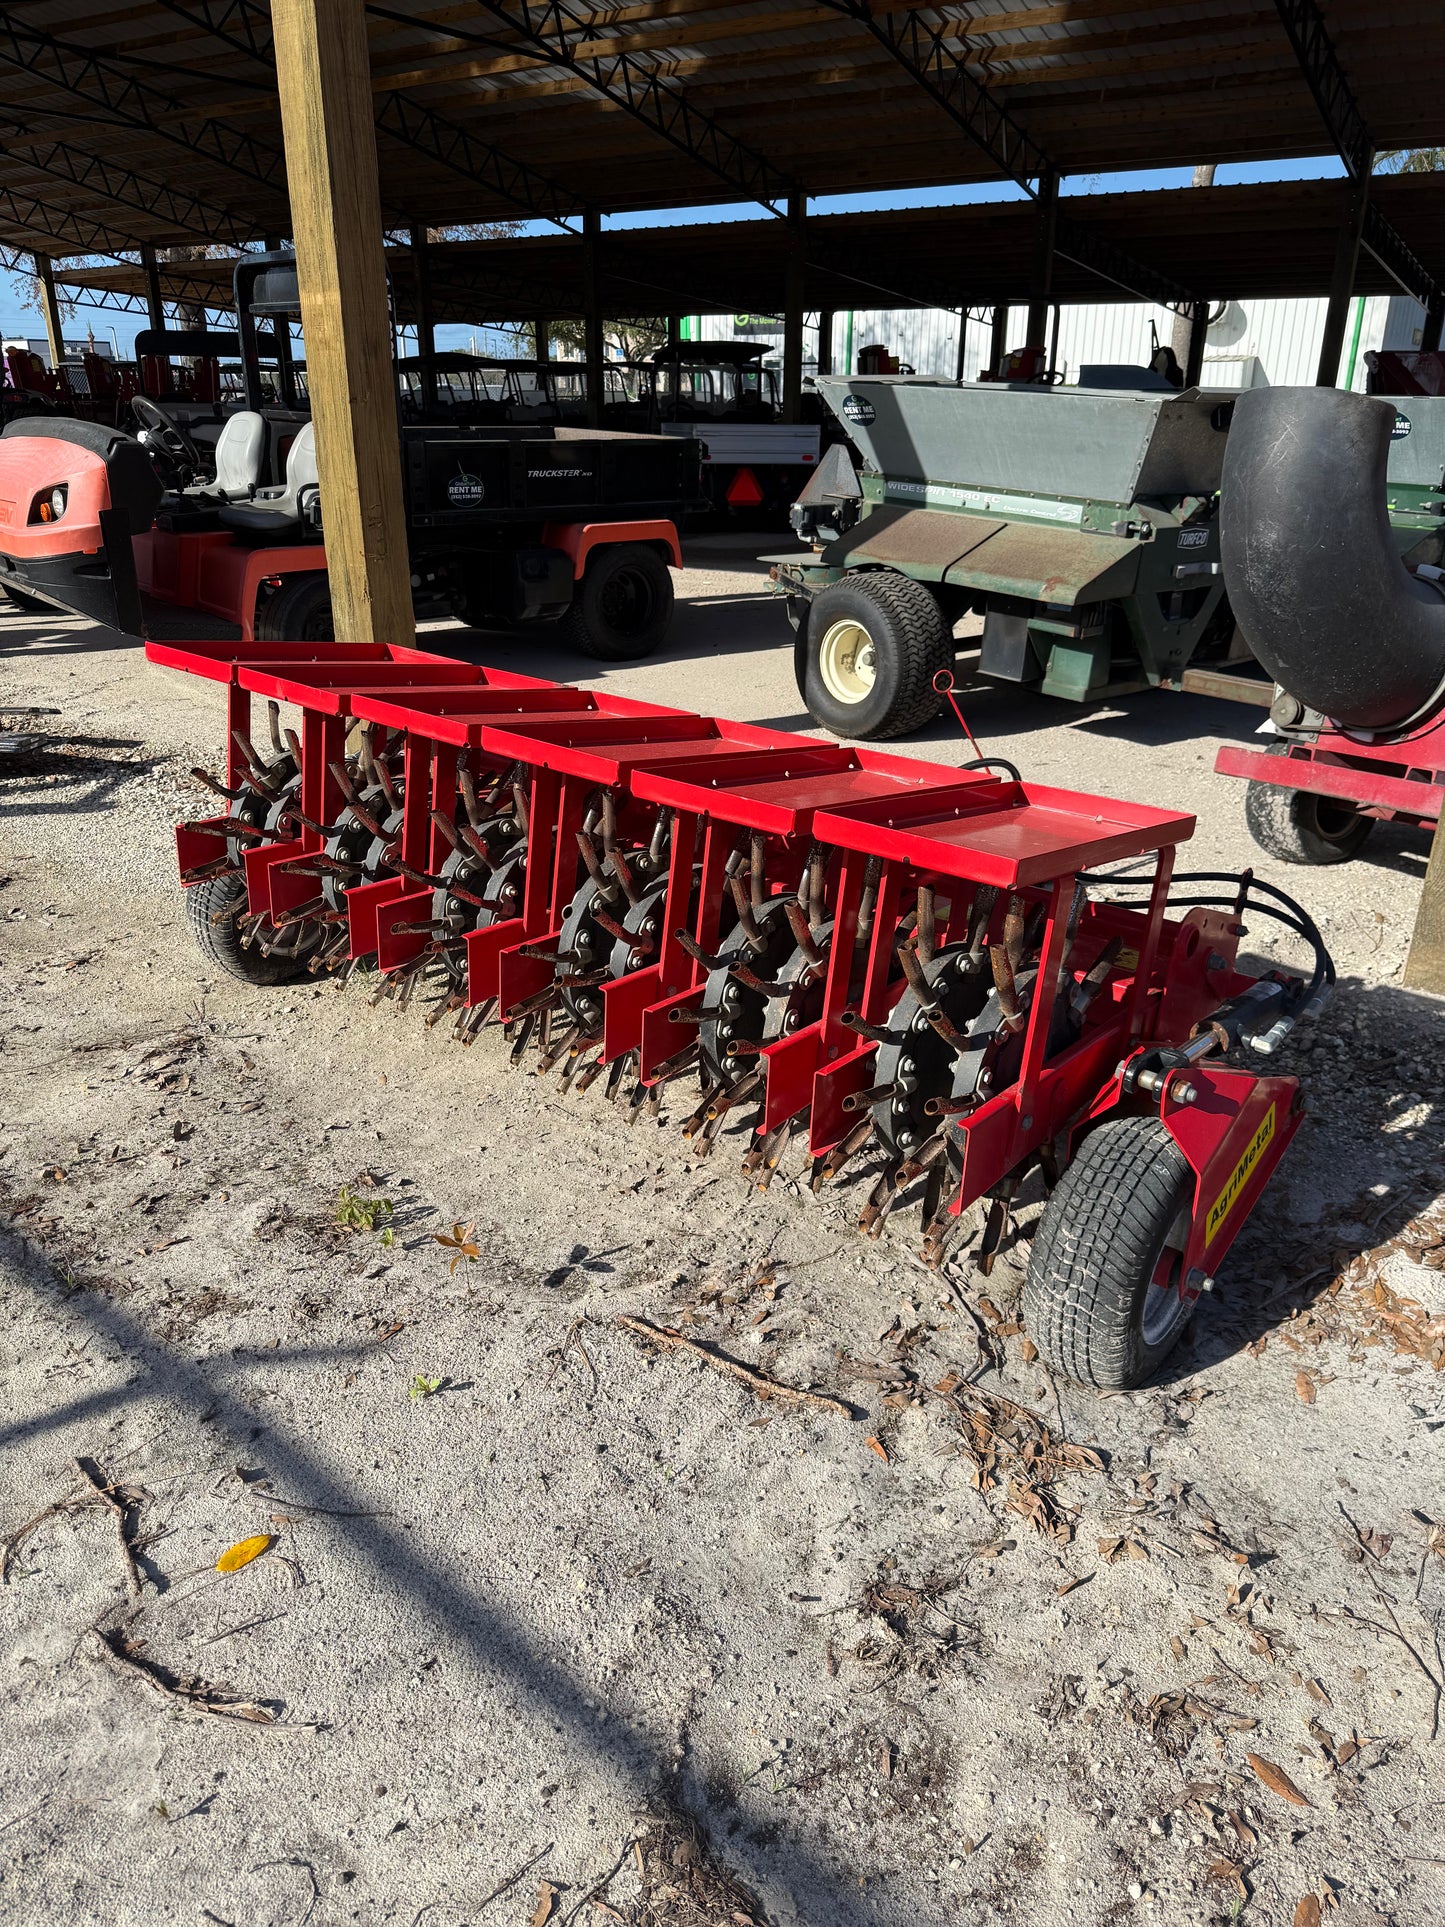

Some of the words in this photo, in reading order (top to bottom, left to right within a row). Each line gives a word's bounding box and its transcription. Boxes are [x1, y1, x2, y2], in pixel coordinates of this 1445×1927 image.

[843, 406, 862, 414] RENT
[862, 405, 875, 413] ME
[1395, 421, 1411, 429] ME
[527, 469, 580, 478] TRUCKSTER
[449, 486, 470, 494] RENT
[470, 485, 483, 493] ME
[950, 490, 980, 500] 1540
[983, 495, 1001, 503] EC
[1180, 532, 1207, 545] TURFCO
[1209, 1111, 1273, 1233] AgriMetal
